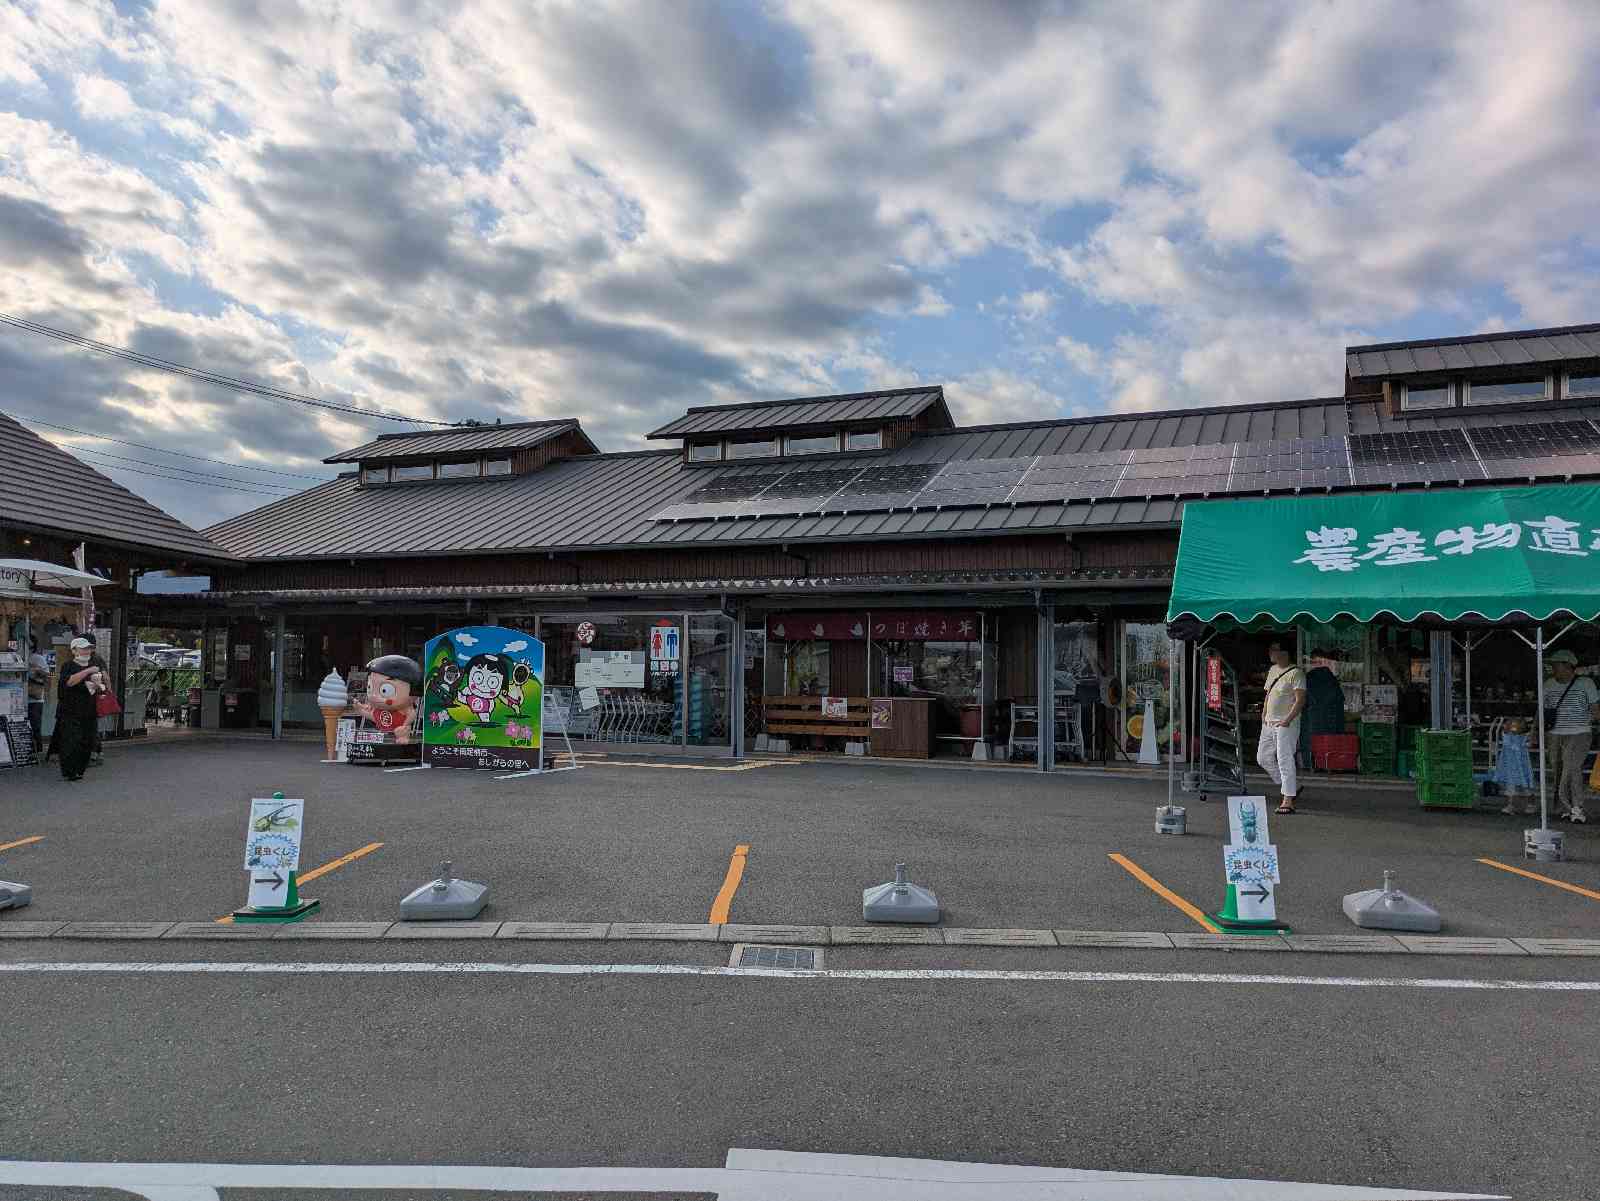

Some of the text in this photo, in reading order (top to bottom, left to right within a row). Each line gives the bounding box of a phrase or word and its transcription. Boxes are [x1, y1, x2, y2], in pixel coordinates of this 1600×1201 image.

[1292, 515, 1600, 572] 農産物直
[0, 567, 20, 584] tory
